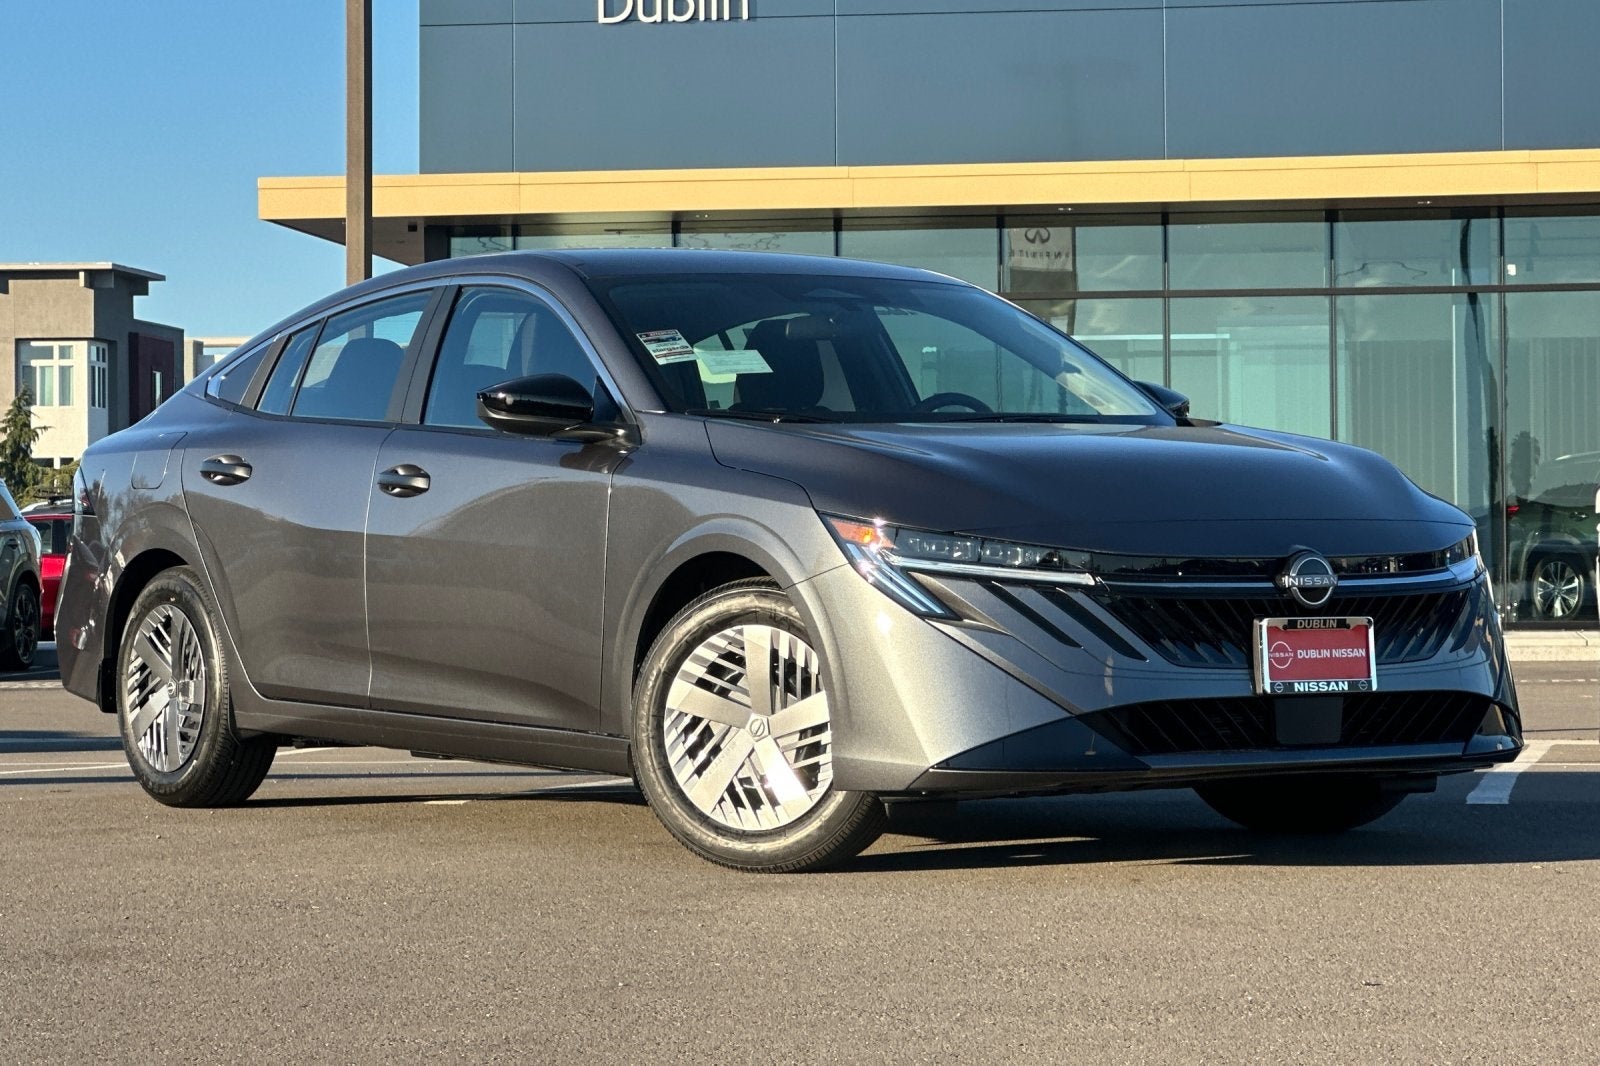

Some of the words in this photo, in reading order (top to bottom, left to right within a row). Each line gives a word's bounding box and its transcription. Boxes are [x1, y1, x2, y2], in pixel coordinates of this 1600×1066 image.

[1289, 577, 1338, 586] NISSAN
[1296, 619, 1338, 629] DUBLIN
[1297, 649, 1331, 659] DUBLIN
[1332, 648, 1366, 657] NISSAN
[1294, 681, 1348, 692] NISSAN
